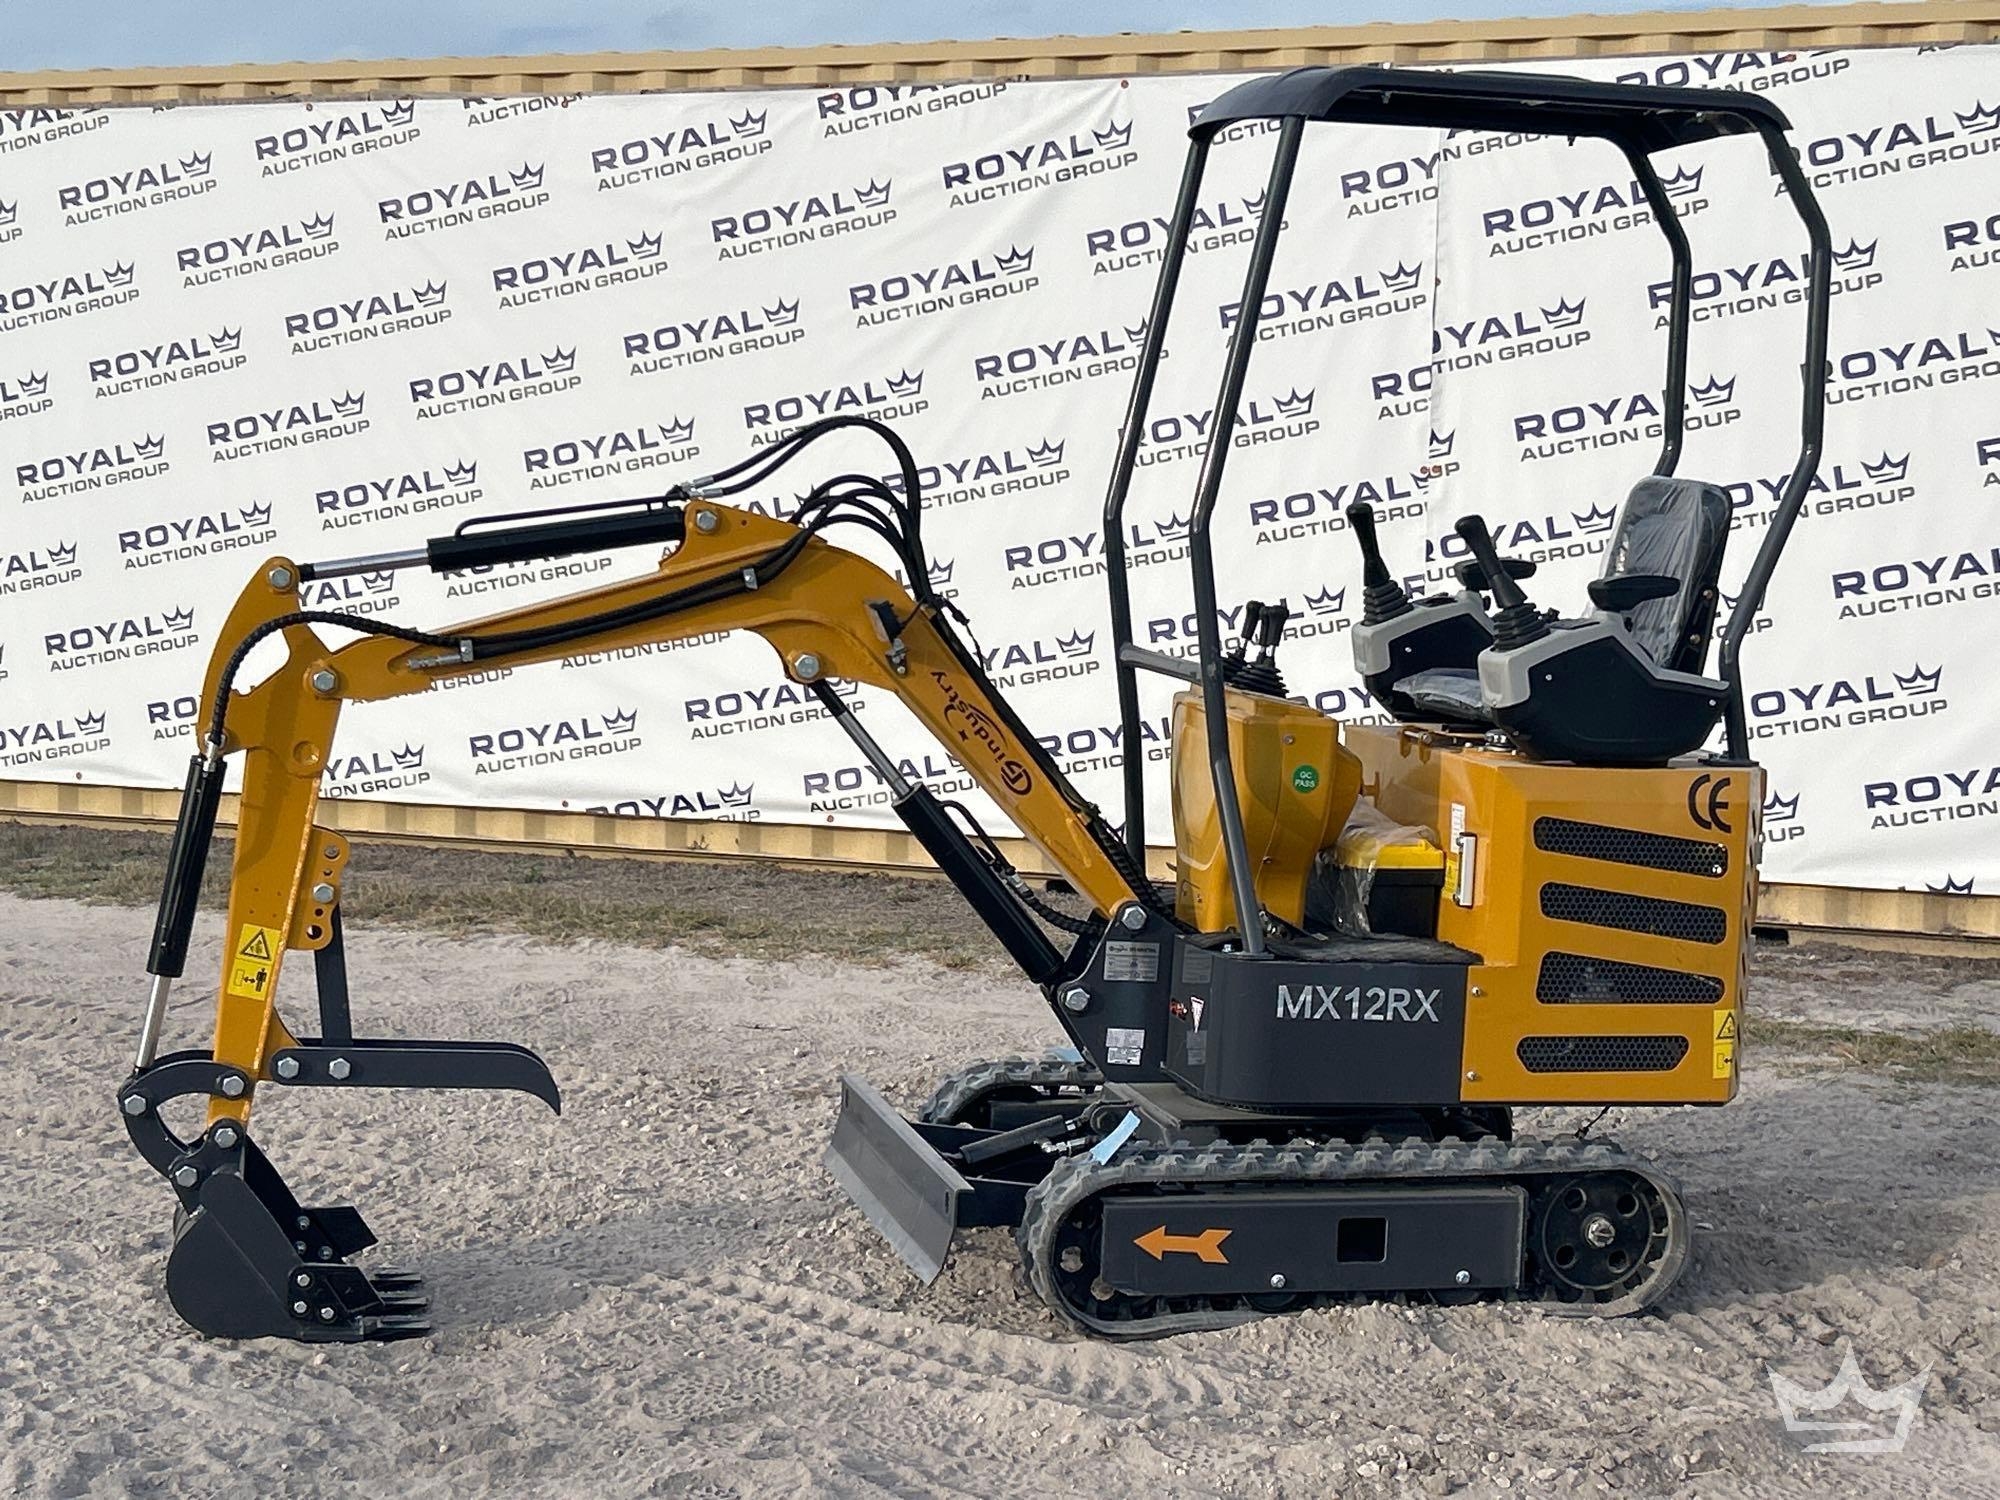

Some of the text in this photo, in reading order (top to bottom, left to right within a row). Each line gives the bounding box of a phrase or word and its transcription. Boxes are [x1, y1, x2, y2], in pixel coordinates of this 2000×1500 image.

[1751, 58, 1850, 91] GROUP
[824, 83, 1007, 138] AUCTION GROUP
[0, 115, 109, 153] TION GROUP
[255, 112, 383, 160] ROYAL
[262, 128, 420, 178] AUCTION GROUP
[591, 122, 731, 174] ROYAL
[598, 140, 772, 192] AUCTION GROUP
[942, 135, 1094, 190] ROYAL
[950, 152, 1138, 208] AUCTION GROUP
[1341, 153, 1440, 199] ROY
[1774, 158, 1901, 197] ACTION
[58, 163, 181, 210] ROYAL
[65, 179, 217, 227] AUCTION GROUP
[378, 175, 511, 224] ROYAL
[1347, 186, 1439, 219] AUCTIO
[385, 192, 550, 241] AUCTION GROUP
[711, 192, 856, 243] ROYAL
[718, 209, 897, 261] AUCTION GROUP
[177, 225, 303, 272] ROYAL
[1094, 220, 1289, 276] AUCTIN GRO
[1489, 220, 1607, 258] AUCTION
[183, 241, 339, 289] AUCTION GROUP
[492, 244, 628, 292] ROYAL
[499, 261, 668, 310] AUCTION GROUP
[849, 259, 996, 310] ROYAL
[0, 289, 140, 332] UCTION GROUP
[285, 292, 414, 338] ROYAL
[856, 276, 1039, 329] AUCTION GROUP
[1226, 294, 1427, 348] CTION GROUP
[1655, 294, 1777, 330] ACTION
[292, 309, 452, 355] AUCTION GROUP
[623, 310, 764, 358] ROYAL
[630, 328, 805, 376] AUCTION GROUP
[1432, 312, 1541, 354] YAL
[1432, 330, 1591, 373] TION GROUP
[89, 338, 211, 382] ROYAL
[95, 355, 247, 399] AUCTION GROUP
[974, 330, 1125, 382] ROYAL
[409, 358, 543, 403] ROYAL
[416, 376, 581, 420] AUCTION GROUP
[981, 367, 1082, 400] AUCTION
[1825, 361, 2000, 405] UCTION GRO
[0, 398, 53, 421] ROUP
[206, 402, 333, 446] ROYAL
[744, 382, 887, 429] ROYAL
[864, 400, 929, 421] ROUP
[1514, 390, 1689, 442] ROYA
[213, 420, 370, 463] AUCTION GROUP
[524, 428, 660, 473] ROYAL
[1234, 420, 1320, 448] GROUP
[1520, 409, 1741, 462] AUCTION GOUP
[16, 444, 135, 487] ROYAL
[22, 462, 170, 504] AUCTION GROUP
[530, 446, 700, 490] AUCTION GROUP
[315, 470, 445, 514] ROYAL
[322, 489, 483, 531] AUCTION GROUP
[888, 469, 1070, 516] CTION GROUP
[1250, 476, 1411, 526] ROYAL
[1815, 486, 1915, 516] GROUP
[118, 512, 241, 554] ROYAL
[124, 530, 277, 570] AUCTION GROUP
[1256, 516, 1352, 546] AUCTIO
[1530, 538, 1610, 564] GROU
[20, 568, 82, 591] GROUP
[298, 578, 363, 607] YAL
[446, 571, 536, 598] AUCTION
[540, 557, 612, 581] GROUP
[1838, 587, 1966, 620] AUCTION
[44, 616, 164, 656] ROYAL
[1283, 618, 1351, 640] ROUP
[50, 634, 199, 672] AUCTION GROUP
[975, 640, 1057, 693] YAL
[1020, 660, 1100, 685] GROUP
[1750, 676, 1895, 717] OYAL
[1848, 699, 1948, 726] GROUP
[0, 720, 76, 750] YAL
[469, 718, 603, 758] ROYAL
[691, 700, 865, 740] AUCTION GROP
[0, 738, 110, 767] TION GROUP
[325, 752, 393, 780] YAL
[475, 738, 642, 775] AUCTION GROUP
[360, 772, 430, 793] GROUP
[1870, 800, 1998, 830] AUCTION
[1276, 985, 1440, 1022] MX12RX
